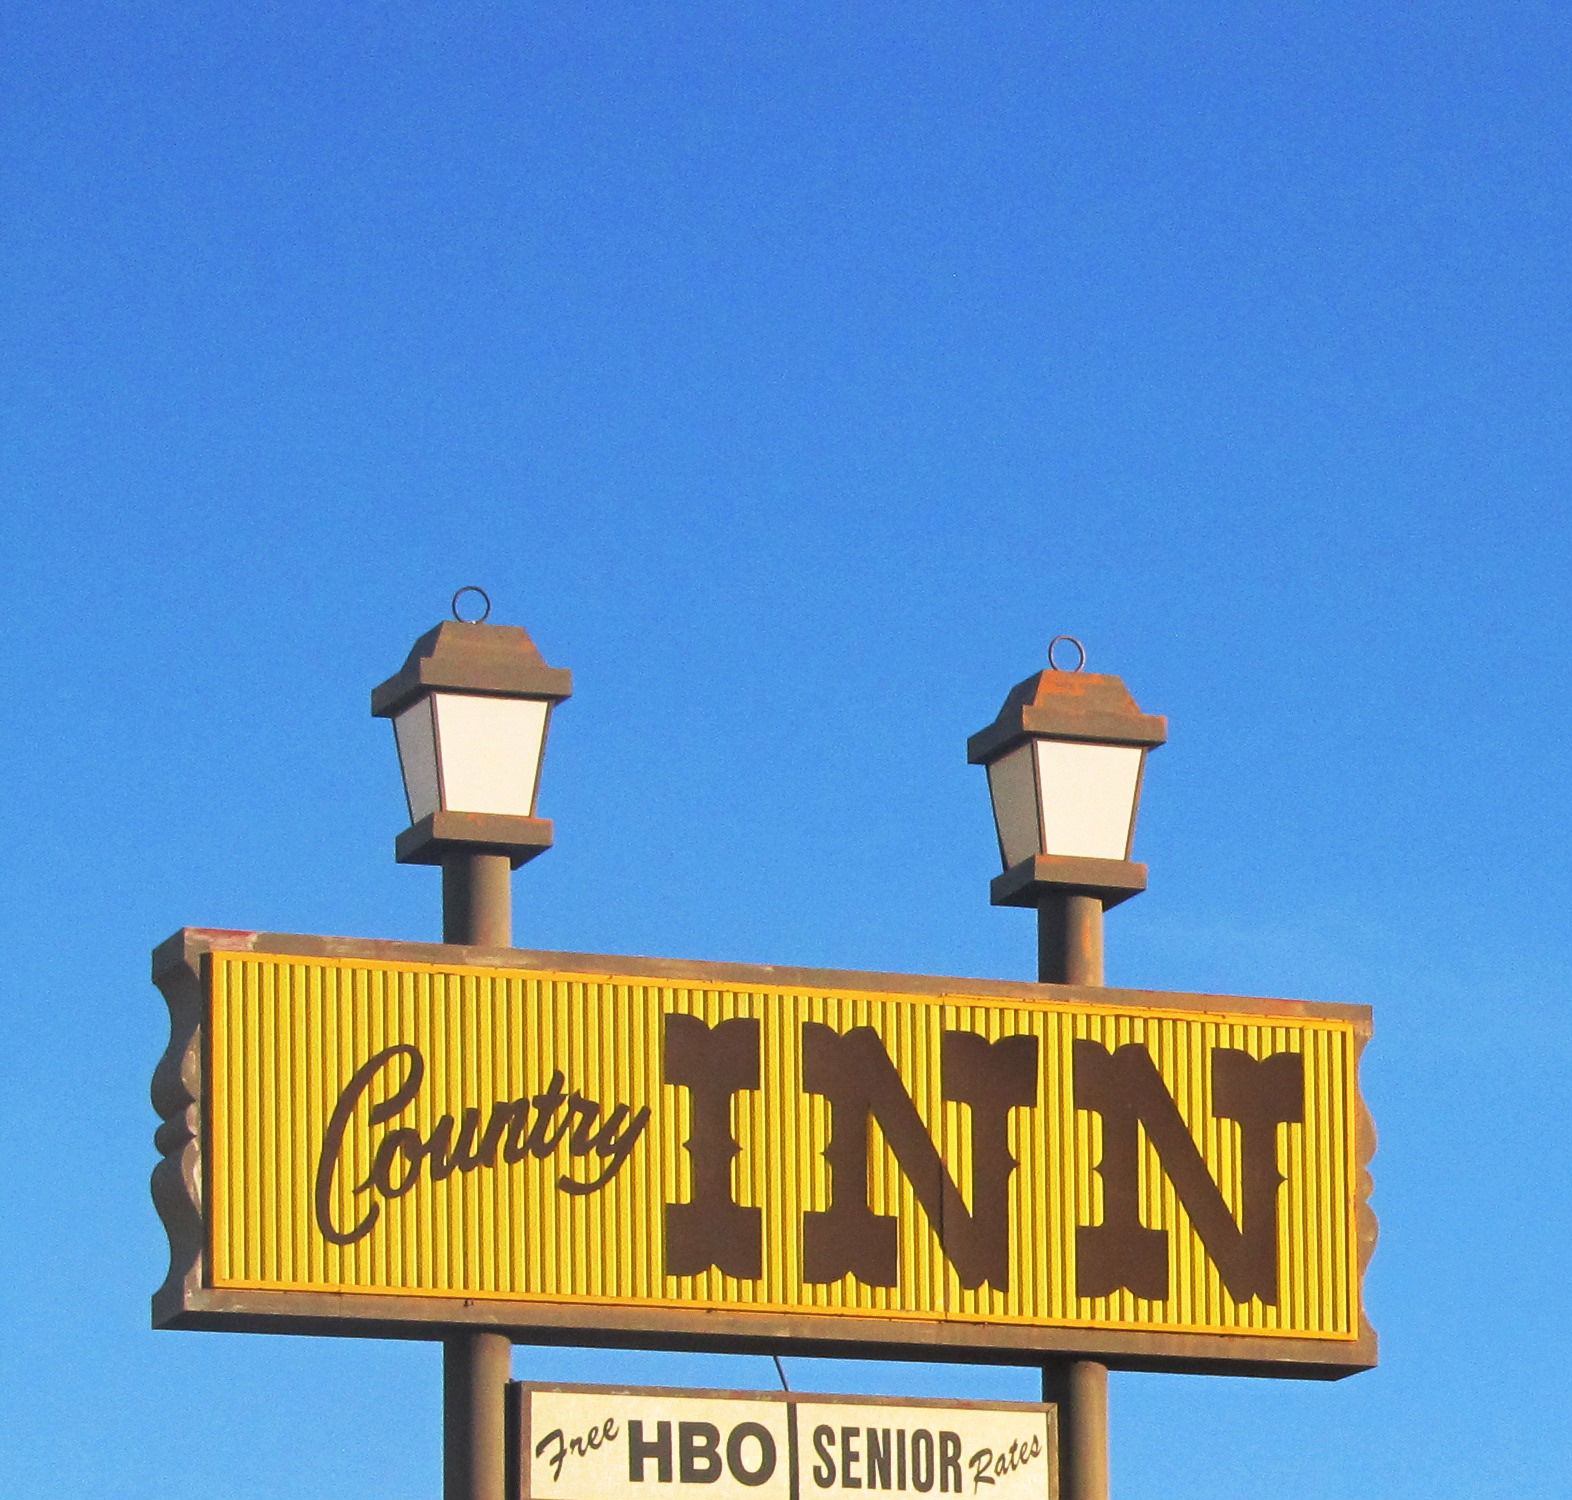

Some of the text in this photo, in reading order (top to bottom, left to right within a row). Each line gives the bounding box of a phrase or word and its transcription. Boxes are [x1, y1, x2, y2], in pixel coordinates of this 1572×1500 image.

[316, 1012, 1304, 1308] Country INN
[535, 1417, 777, 1487] Free HBO
[812, 1424, 1041, 1494] SENIOR Rates
